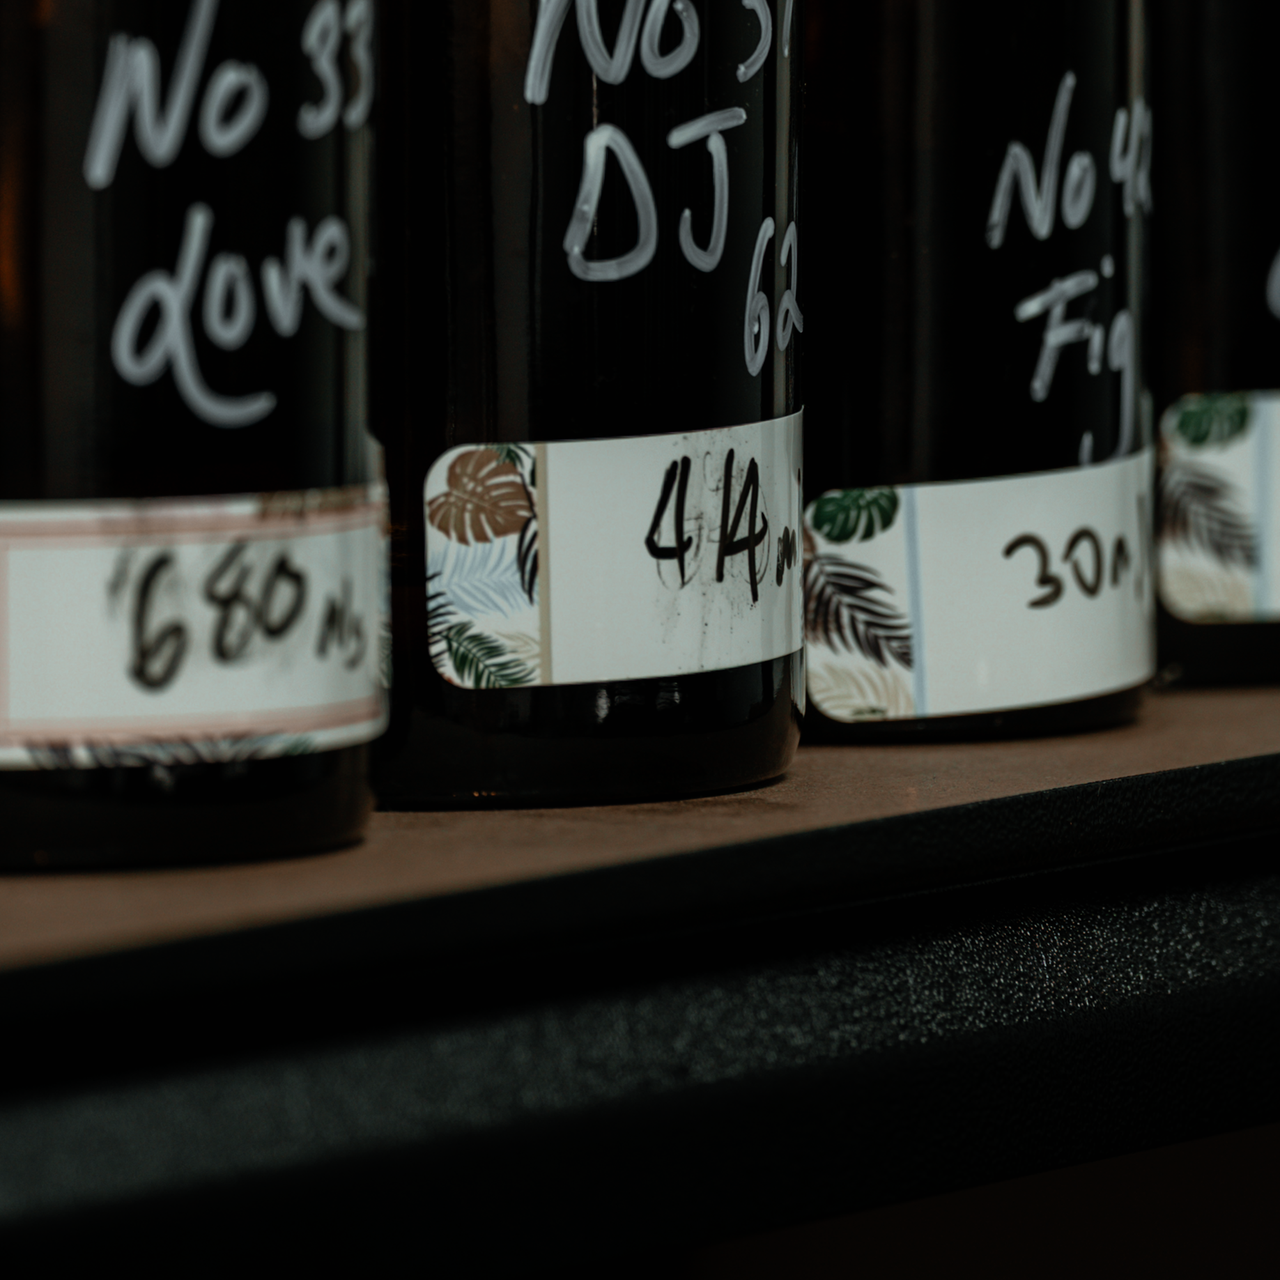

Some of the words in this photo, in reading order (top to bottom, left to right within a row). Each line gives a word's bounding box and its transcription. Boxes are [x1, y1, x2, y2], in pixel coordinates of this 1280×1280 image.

[563, 107, 747, 282] DJ
[985, 69, 1098, 250] No
[743, 216, 804, 377] 62
[128, 538, 306, 692] 680
